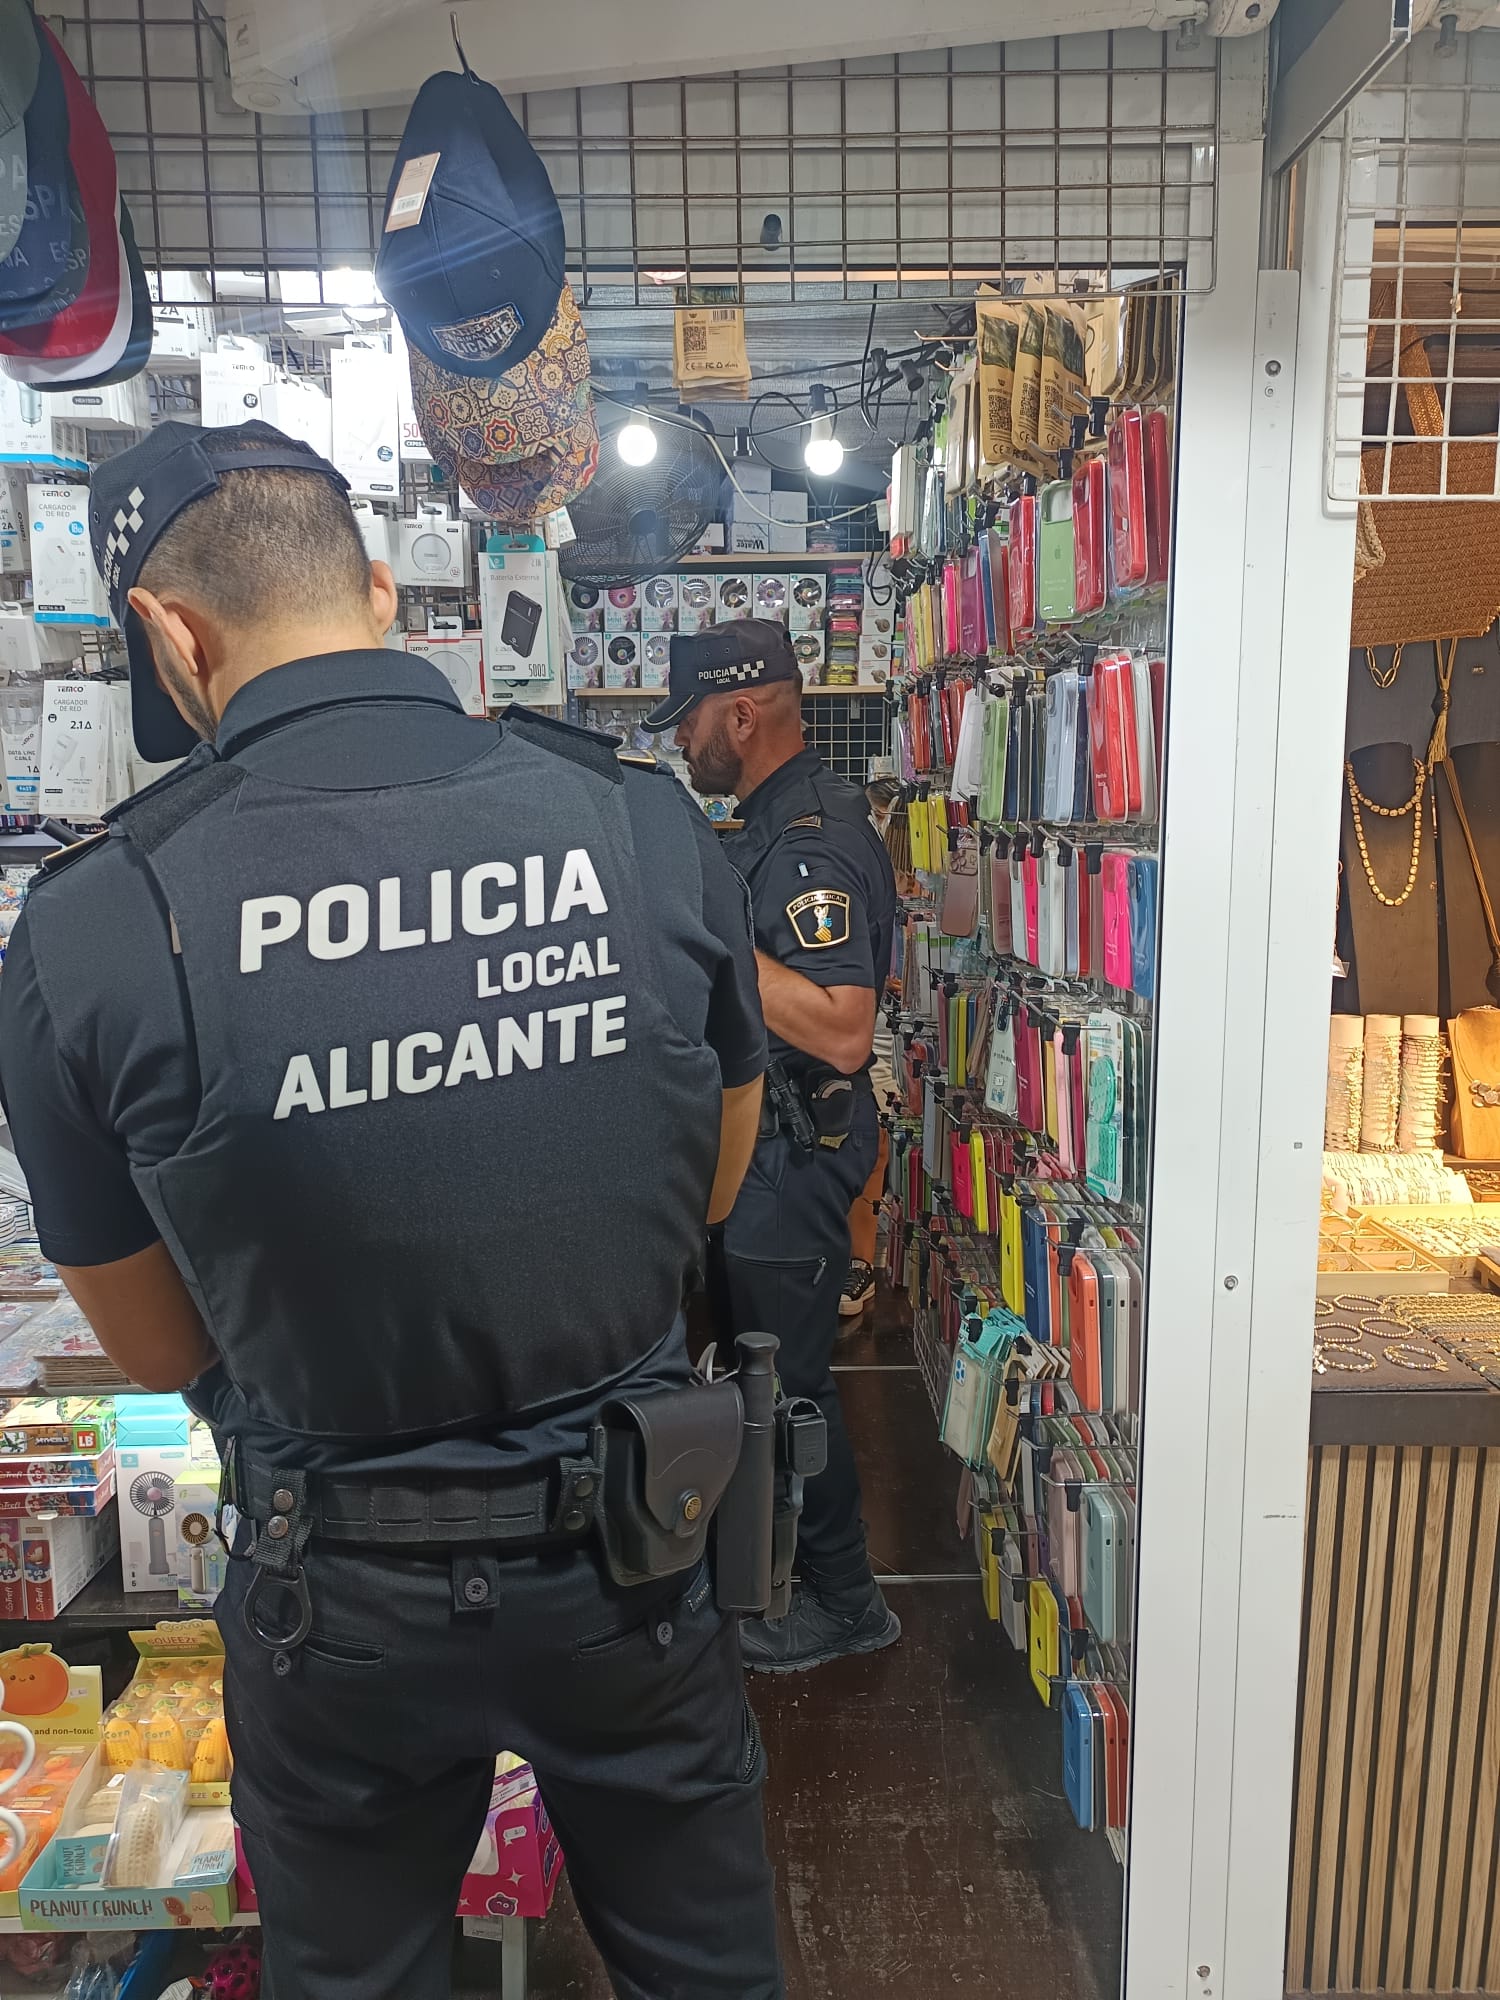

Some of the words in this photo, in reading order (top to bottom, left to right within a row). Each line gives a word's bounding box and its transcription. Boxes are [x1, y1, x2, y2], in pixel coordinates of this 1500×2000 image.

[444, 320, 512, 353] ALICANTE
[38, 503, 77, 511] CARGADOR
[698, 668, 730, 680] POLICIA
[239, 848, 609, 974] POLICIA
[477, 936, 620, 999] LOCAL
[272, 995, 627, 1120] ALICANTE
[78, 1435, 94, 1447] LB
[104, 1730, 130, 1740] Corn
[144, 1730, 171, 1739] Corn
[186, 1727, 213, 1738] Corn
[63, 1846, 73, 1879] PEANUT
[30, 1899, 89, 1917] PEANUT
[92, 1898, 153, 1917] CRUNCH
